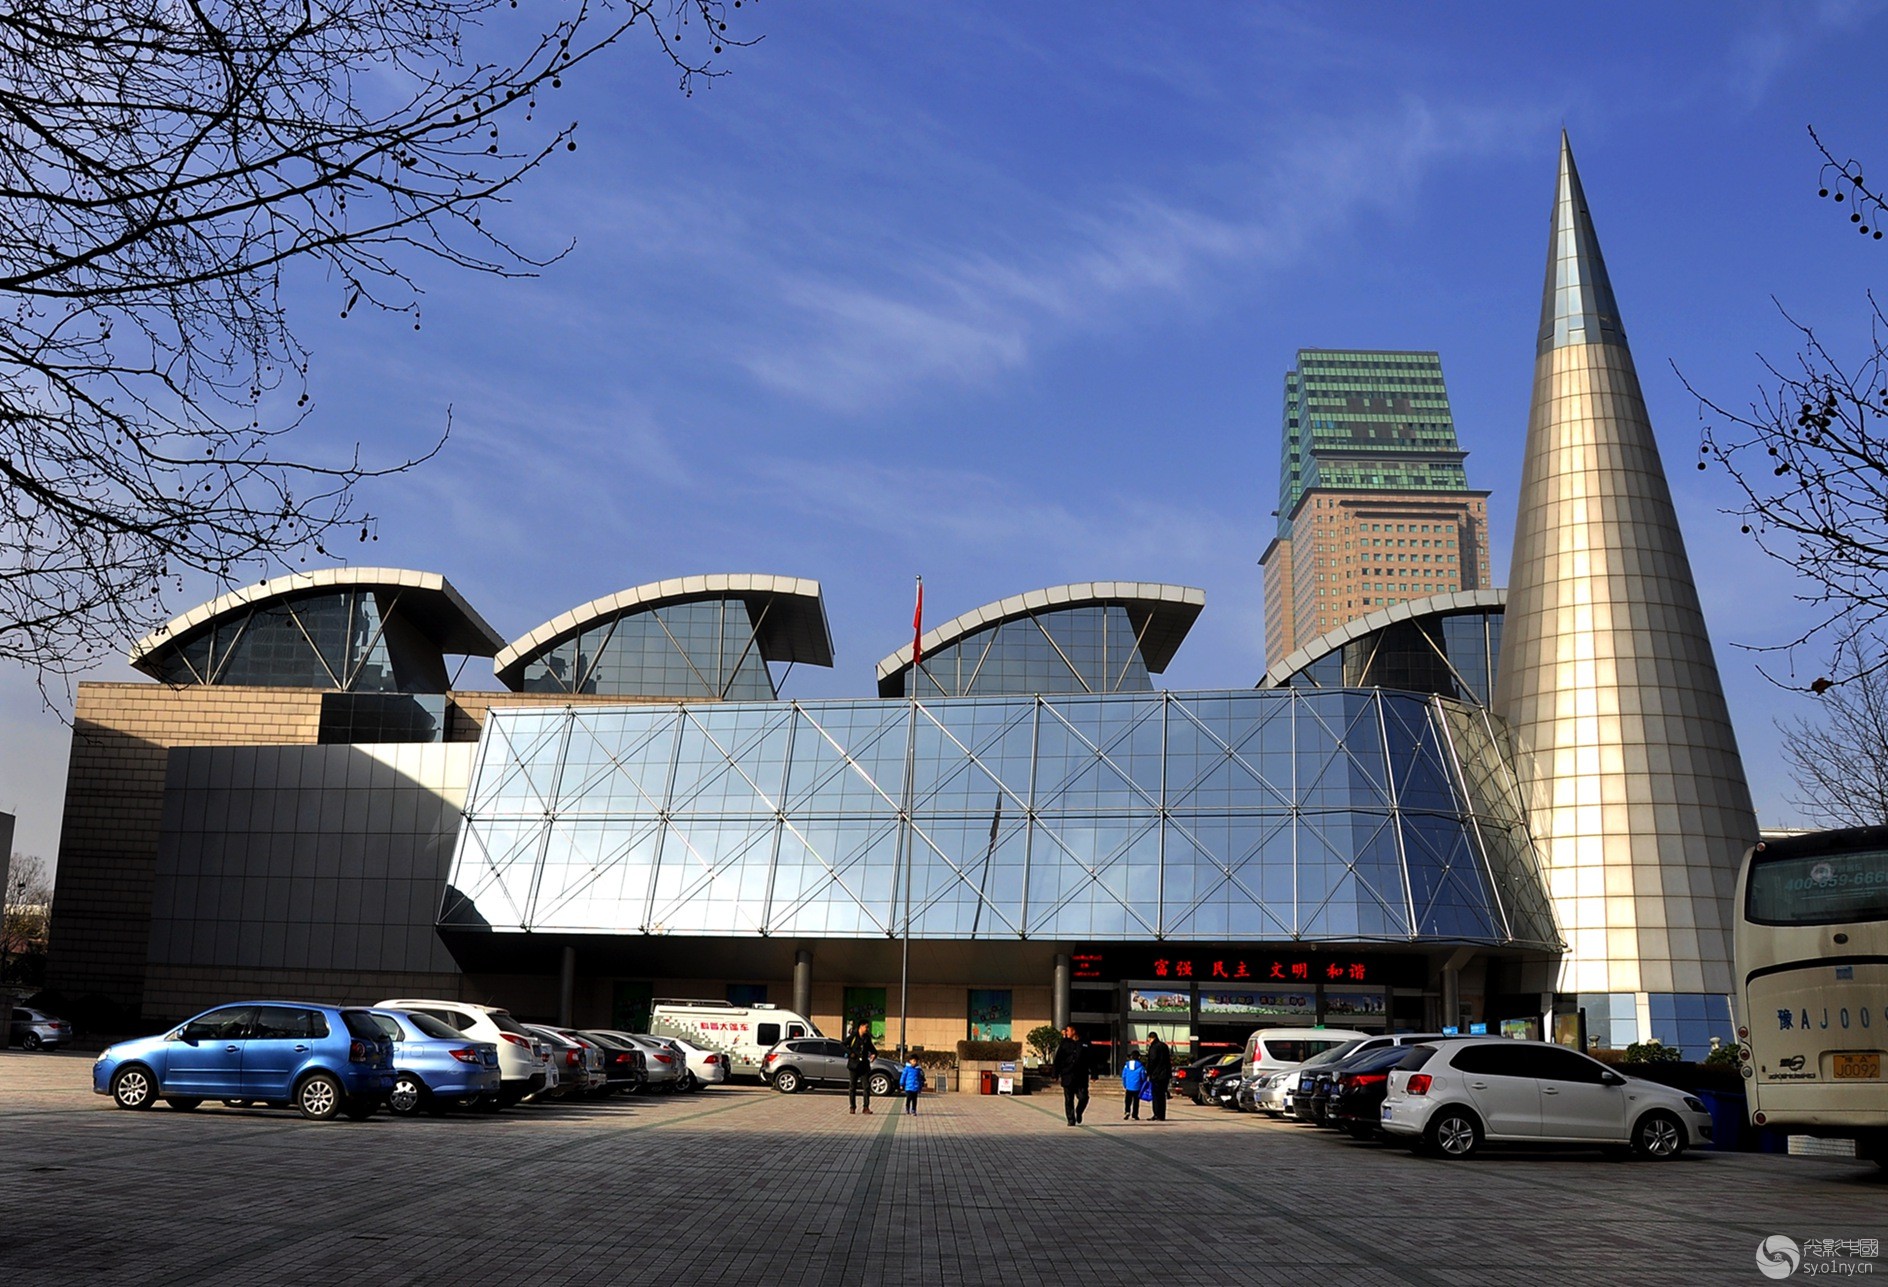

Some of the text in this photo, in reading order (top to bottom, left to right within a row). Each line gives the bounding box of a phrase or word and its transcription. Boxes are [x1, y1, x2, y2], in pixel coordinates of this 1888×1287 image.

[1784, 871, 1888, 891] 400-659-666
[1154, 959, 1366, 980] 富强 民主 文明 和谐
[1777, 1007, 1888, 1031] 豫AJ00
[1836, 1064, 1878, 1077] J0092
